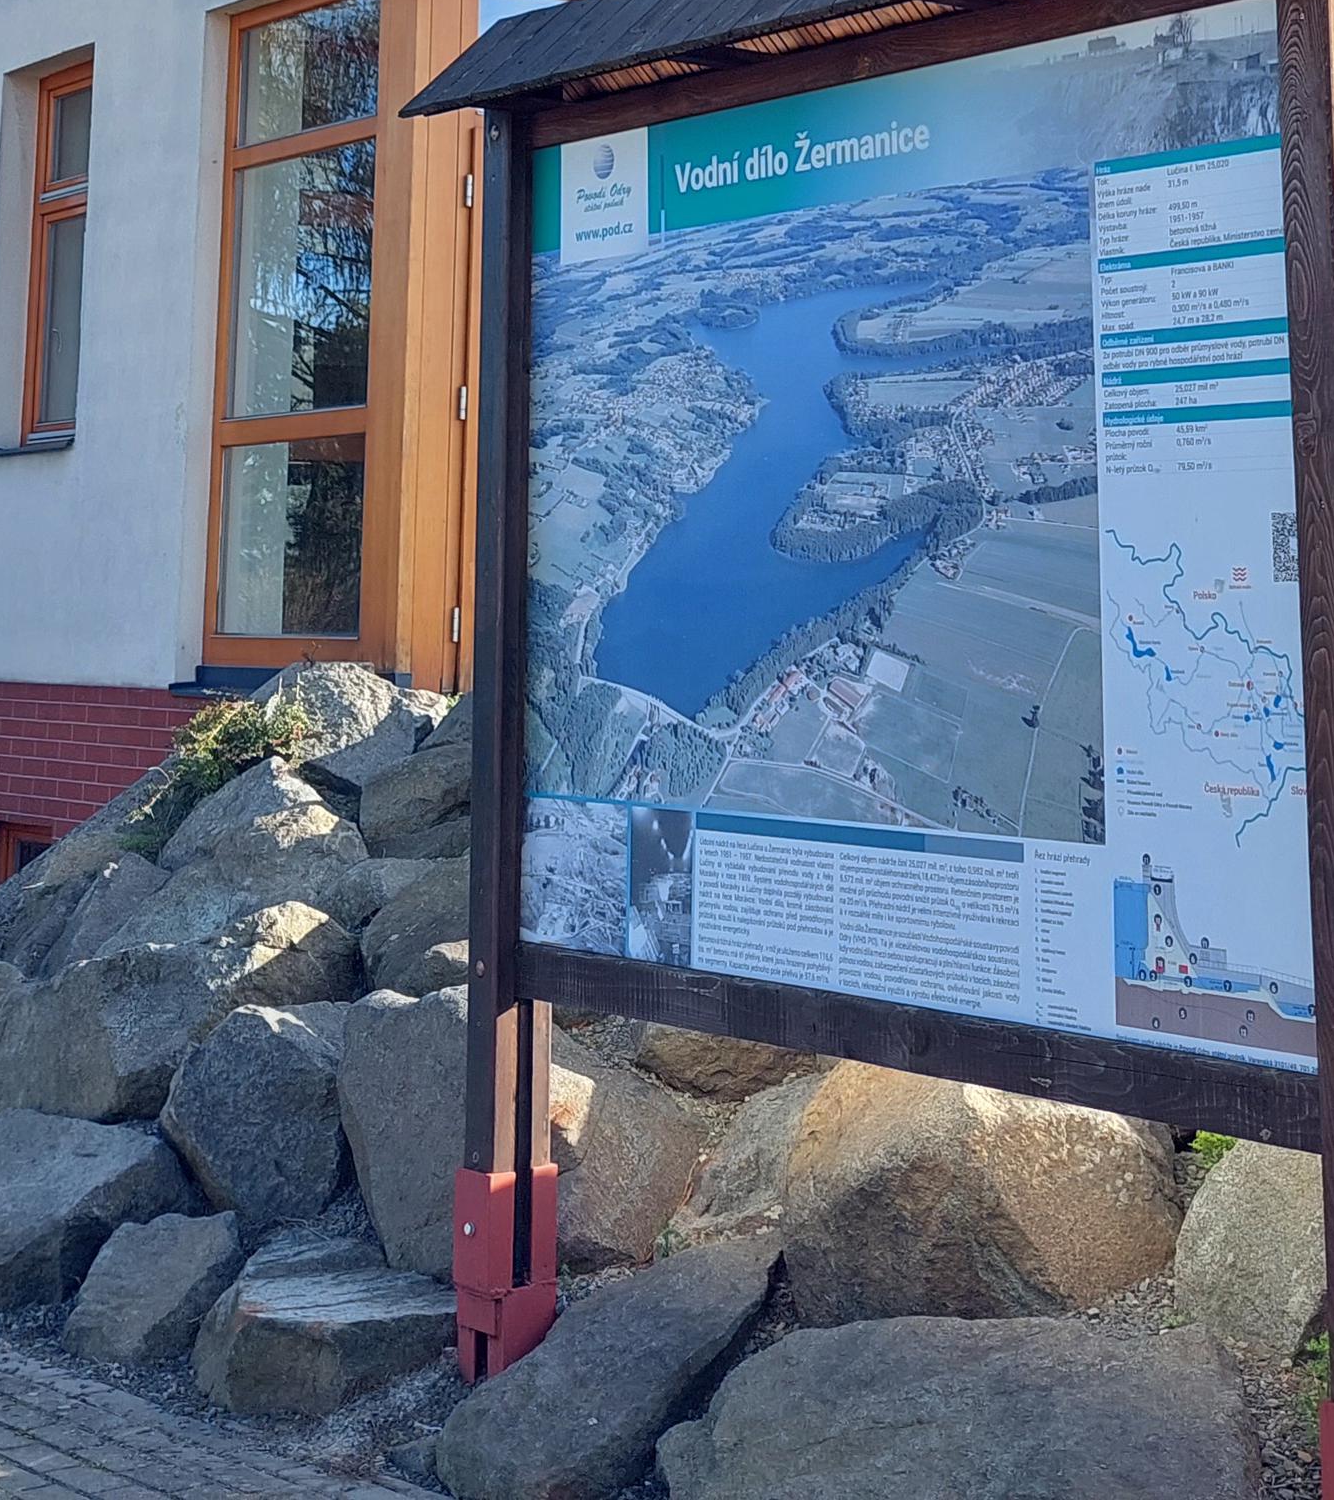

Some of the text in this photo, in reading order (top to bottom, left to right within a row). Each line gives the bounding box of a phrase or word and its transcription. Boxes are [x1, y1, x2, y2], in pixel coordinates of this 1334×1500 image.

[674, 121, 930, 193] Vodní dílo Žermanice
[1167, 165, 1188, 176] Lučina
[1195, 162, 1206, 171] km
[610, 183, 632, 198] Odry
[1097, 187, 1115, 196] Výška
[1117, 185, 1133, 194] hráze
[1097, 199, 1115, 209] dnem
[1097, 211, 1115, 221] Délka
[1117, 208, 1137, 220] koruny
[575, 221, 634, 242] www.pod.cz
[1169, 225, 1199, 236] betonová
[1099, 236, 1110, 246] Typ
[1169, 236, 1189, 248] Česká
[1223, 229, 1265, 241] Ministerstvo
[1101, 287, 1118, 295] Počet
[1171, 292, 1180, 300] 50
[1181, 291, 1191, 299] kW
[1197, 289, 1207, 297] 90
[1208, 288, 1219, 296] kW
[1101, 298, 1120, 307] Výkon
[1111, 349, 1133, 360] potrubí
[1134, 348, 1145, 356] DN
[1145, 347, 1157, 355] 900
[1159, 348, 1169, 356] pro
[1171, 344, 1189, 353] odběr
[1248, 338, 1273, 348] potrubí
[1273, 337, 1285, 345] DN
[1121, 360, 1137, 370] vody
[1138, 361, 1149, 369] pro
[1213, 353, 1226, 363] pod
[1197, 383, 1208, 391] mil
[1103, 389, 1127, 397] Celkový
[1175, 396, 1197, 405] 247 ha
[1105, 428, 1127, 437] Plocha
[1193, 591, 1217, 600] Polska
[1203, 782, 1260, 798] Česká republika
